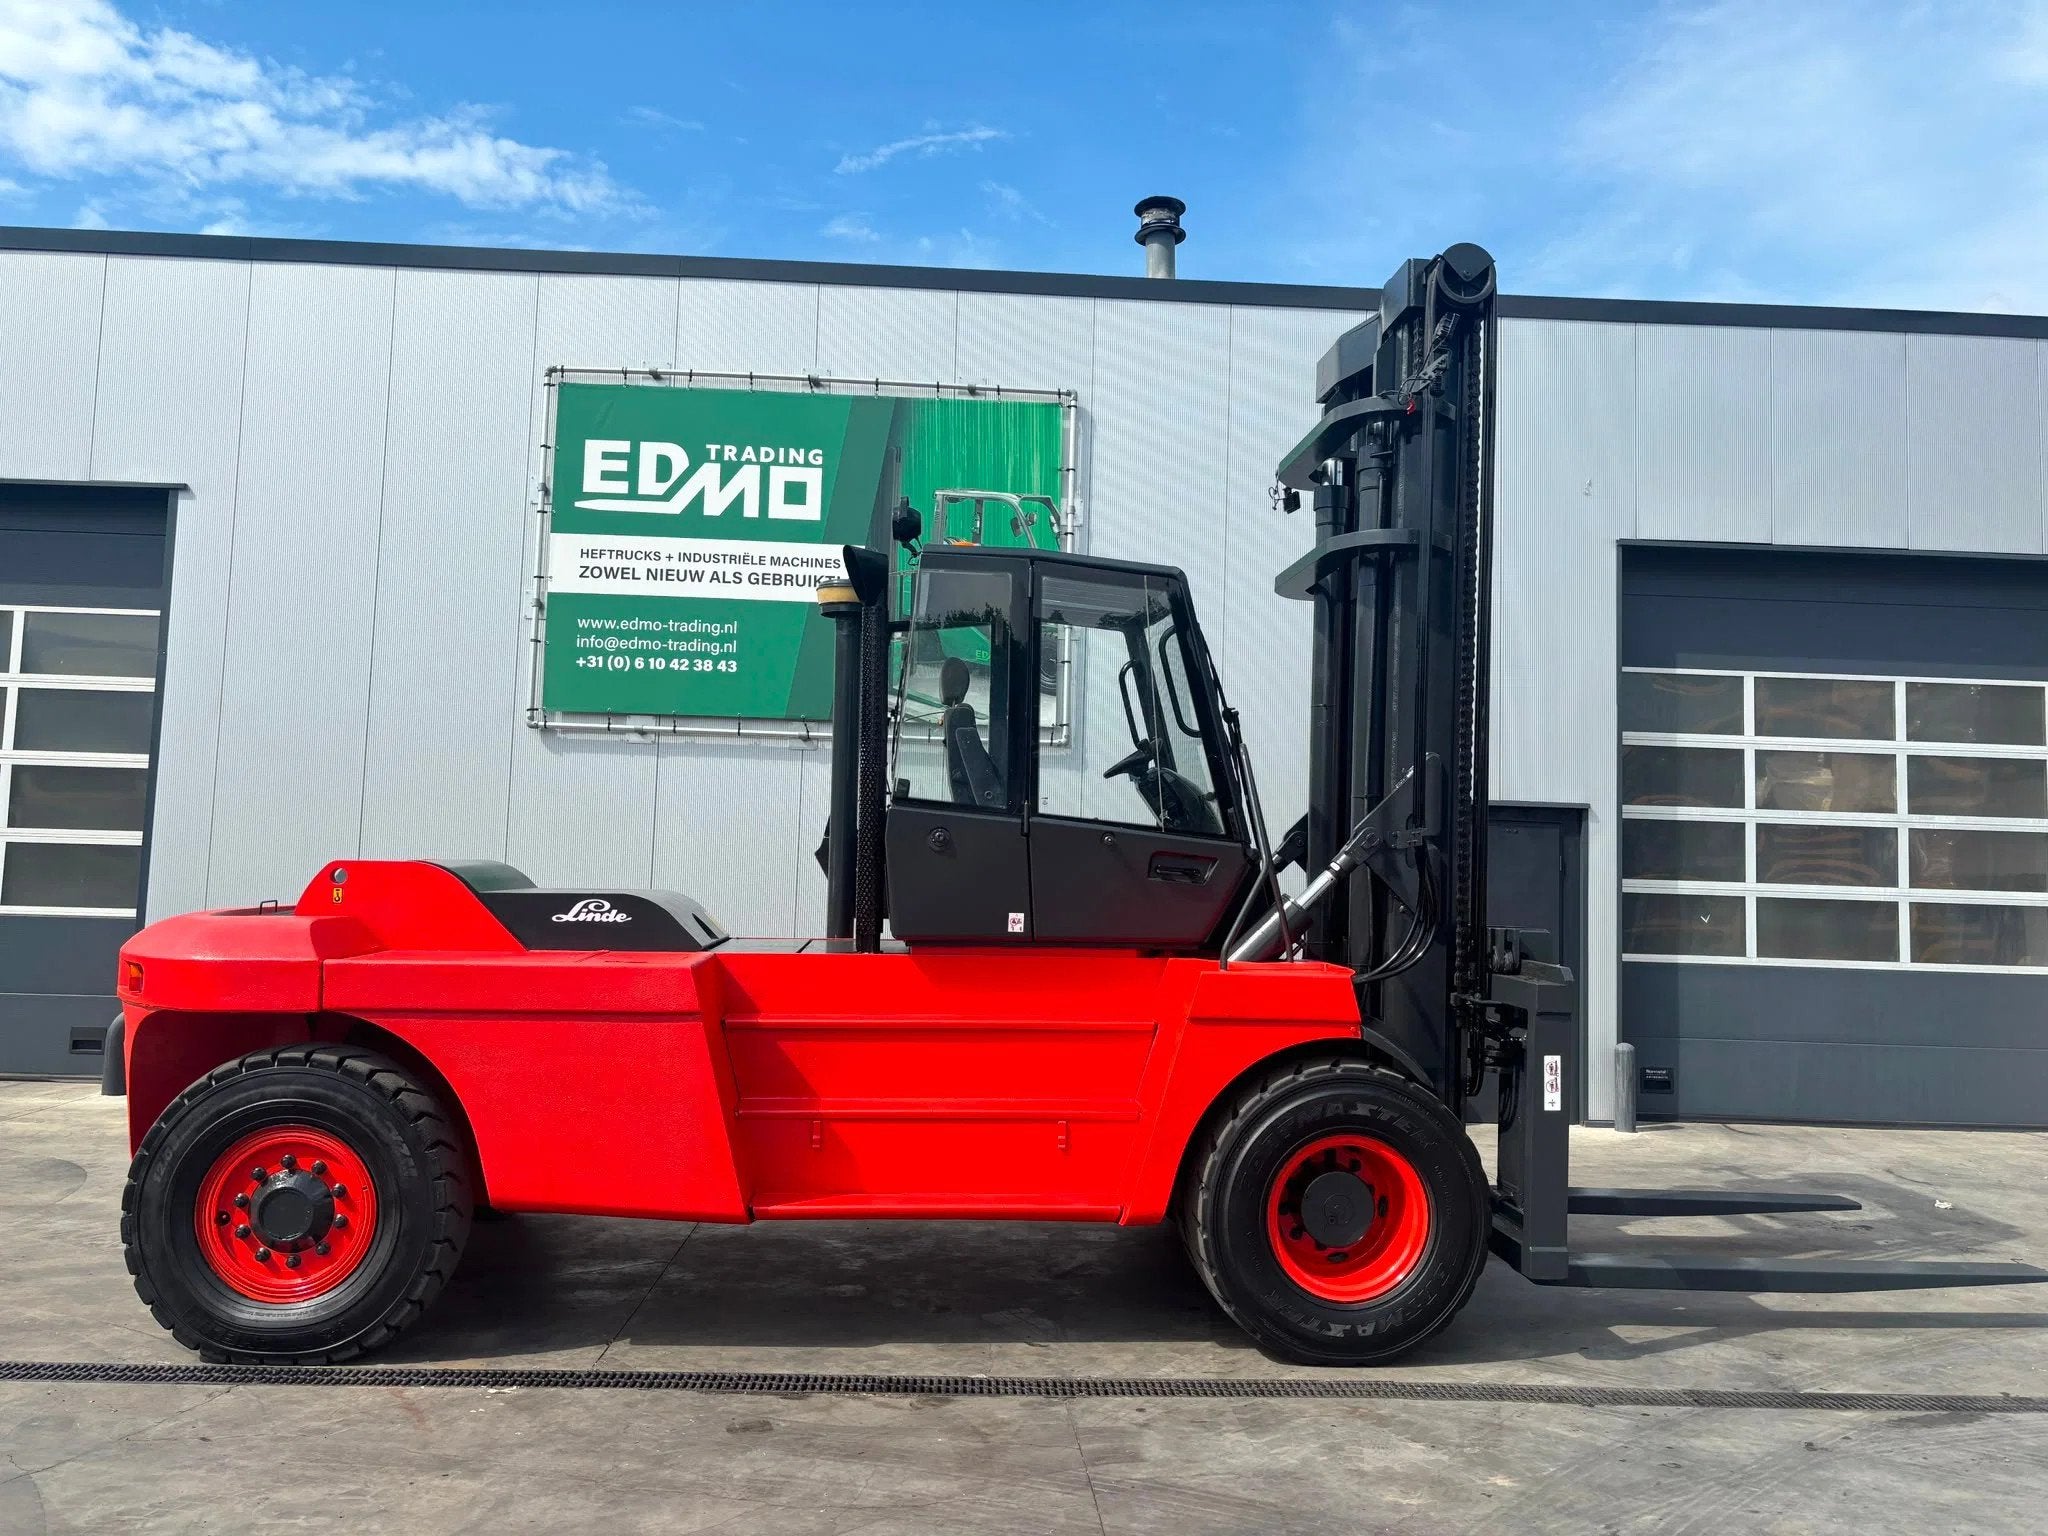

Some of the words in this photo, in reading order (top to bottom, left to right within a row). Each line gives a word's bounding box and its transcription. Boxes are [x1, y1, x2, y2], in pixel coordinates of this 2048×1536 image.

[705, 443, 823, 465] TRADING
[574, 439, 823, 521] EDMO
[580, 548, 661, 562] HEFTRUCKS
[666, 553, 674, 562] +
[678, 552, 766, 566] INDUSTRIËLE
[770, 556, 841, 569] MACHINES
[579, 565, 641, 581] ZOWEL
[646, 568, 705, 583] NIEUW
[709, 570, 743, 585] ALS
[748, 572, 840, 588] GEBRUIKT
[577, 617, 738, 636] www.edmo-trading.nl
[576, 634, 737, 655] info@edmo-trading.nl
[576, 655, 603, 668] +31
[607, 655, 631, 672] (0)
[634, 657, 645, 670] 6
[648, 657, 666, 670] 10
[669, 658, 690, 671] 42
[693, 659, 713, 672] 38
[716, 660, 738, 672] 43
[551, 898, 633, 923] Linde
